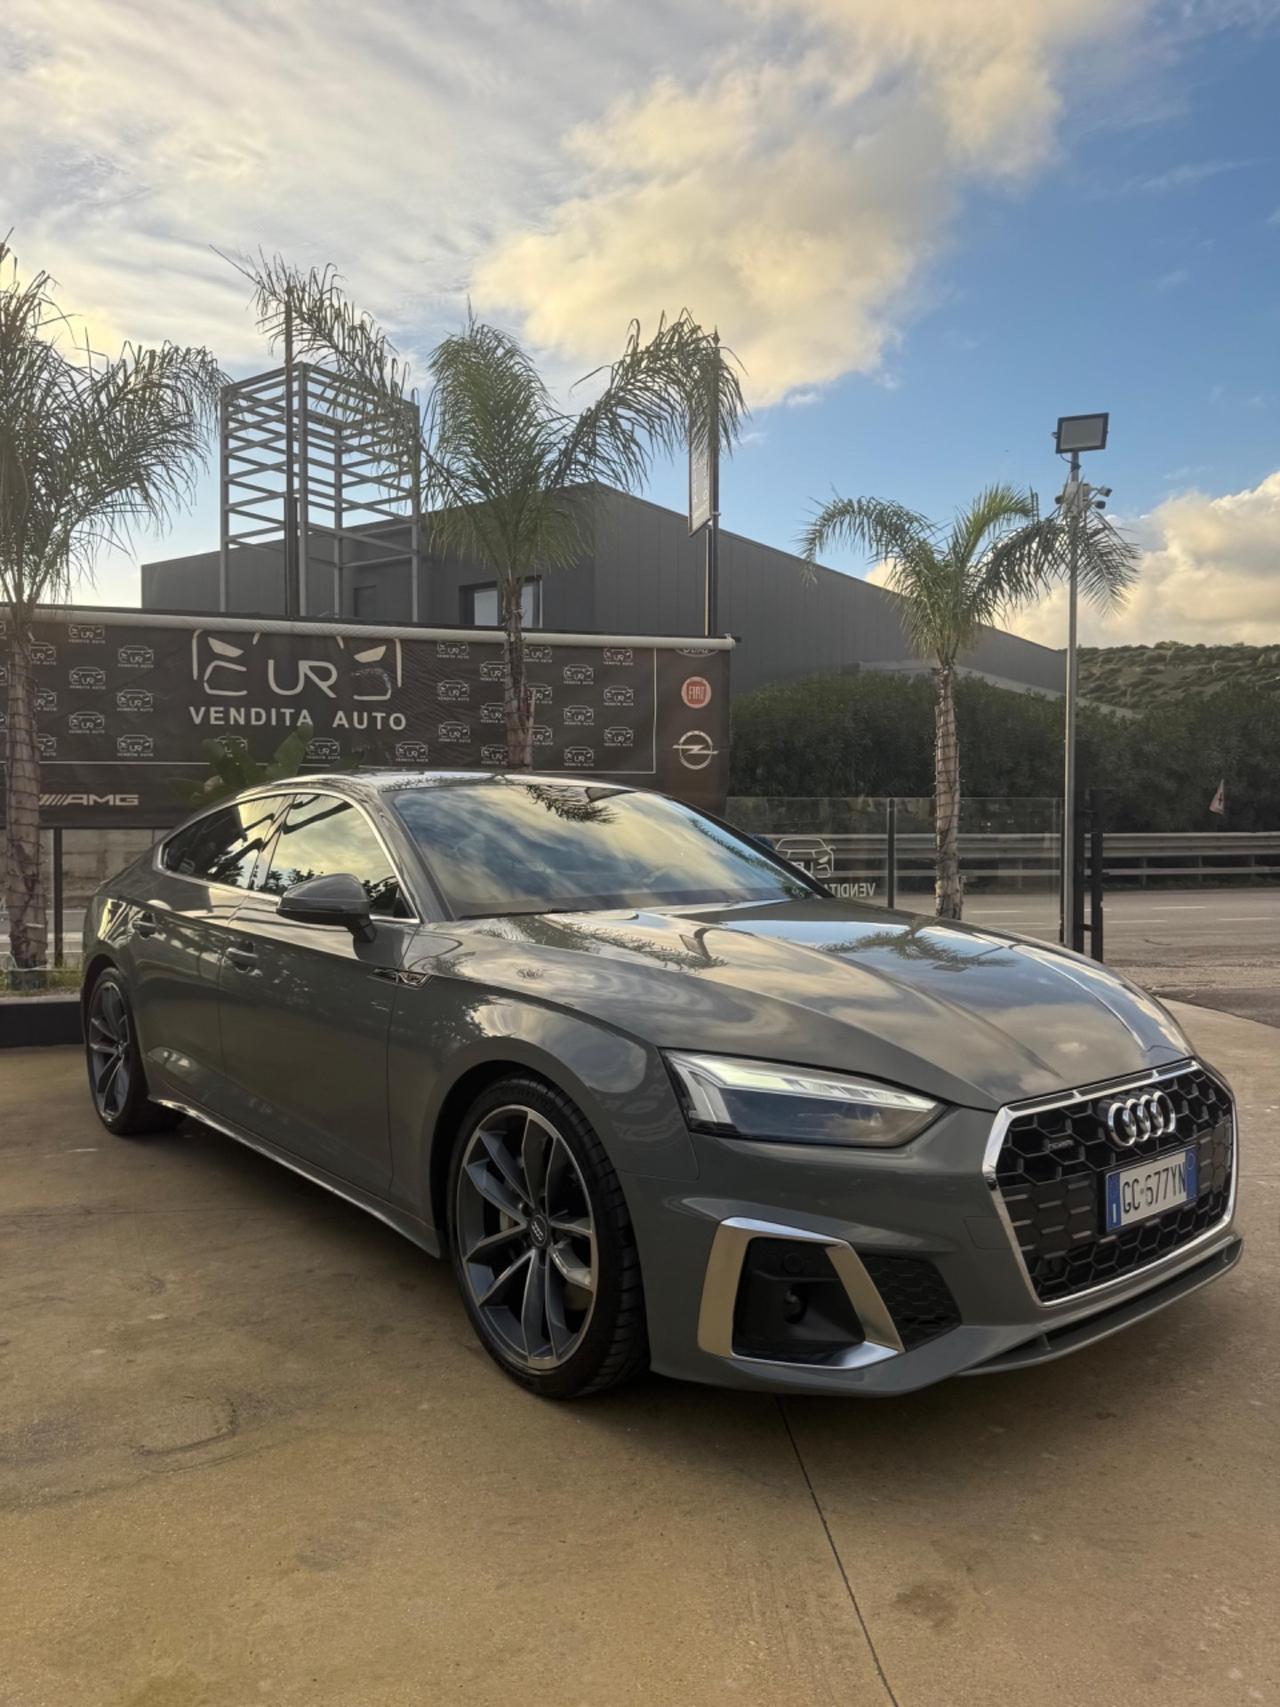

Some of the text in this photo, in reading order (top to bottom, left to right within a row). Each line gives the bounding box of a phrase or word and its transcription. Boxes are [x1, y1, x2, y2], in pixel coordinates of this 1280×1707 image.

[688, 686, 706, 700] FIAT
[189, 706, 407, 730] VENDITA AUTO
